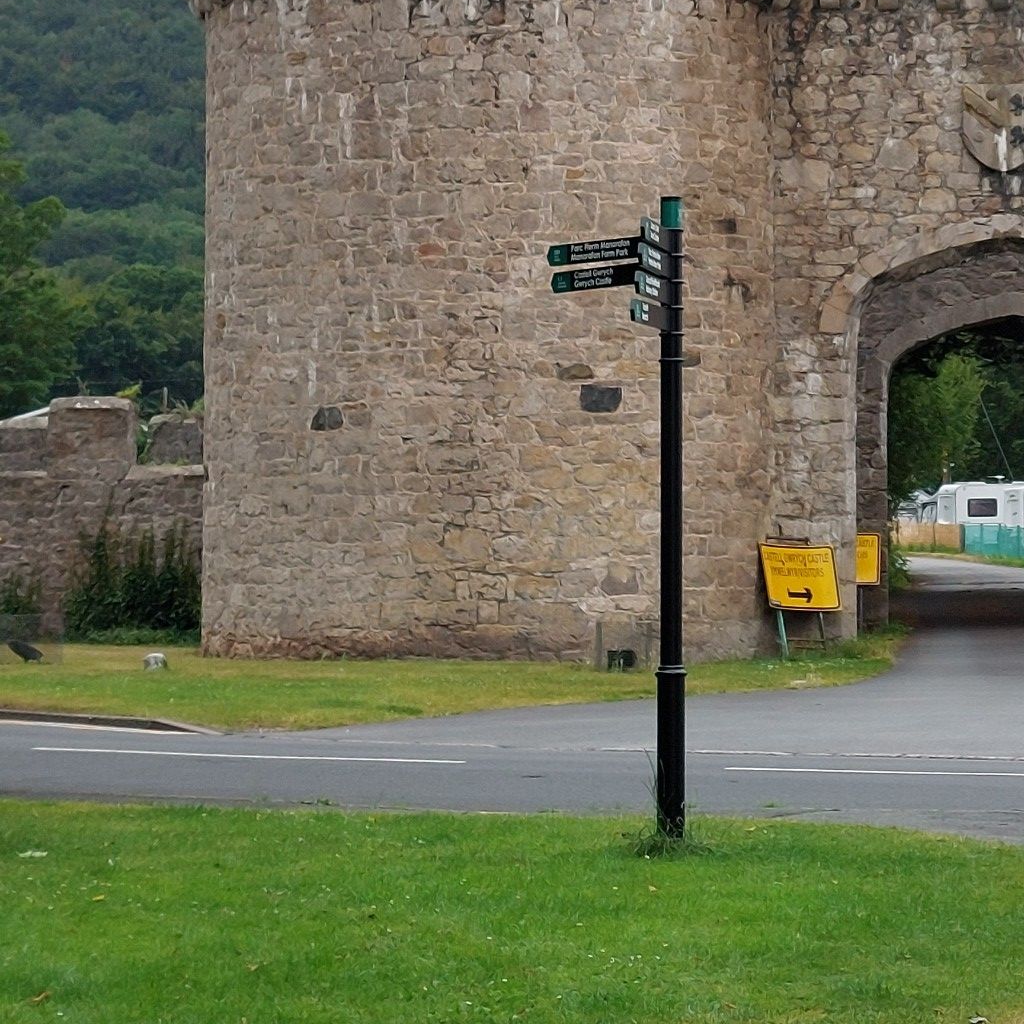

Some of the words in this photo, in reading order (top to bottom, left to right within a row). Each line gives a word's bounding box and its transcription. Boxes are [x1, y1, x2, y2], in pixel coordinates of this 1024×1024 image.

[601, 250, 615, 258] Farm
[615, 248, 628, 257] Park
[592, 267, 613, 278] Gwrych
[574, 279, 594, 289] Gwrych
[595, 276, 612, 286] Castle
